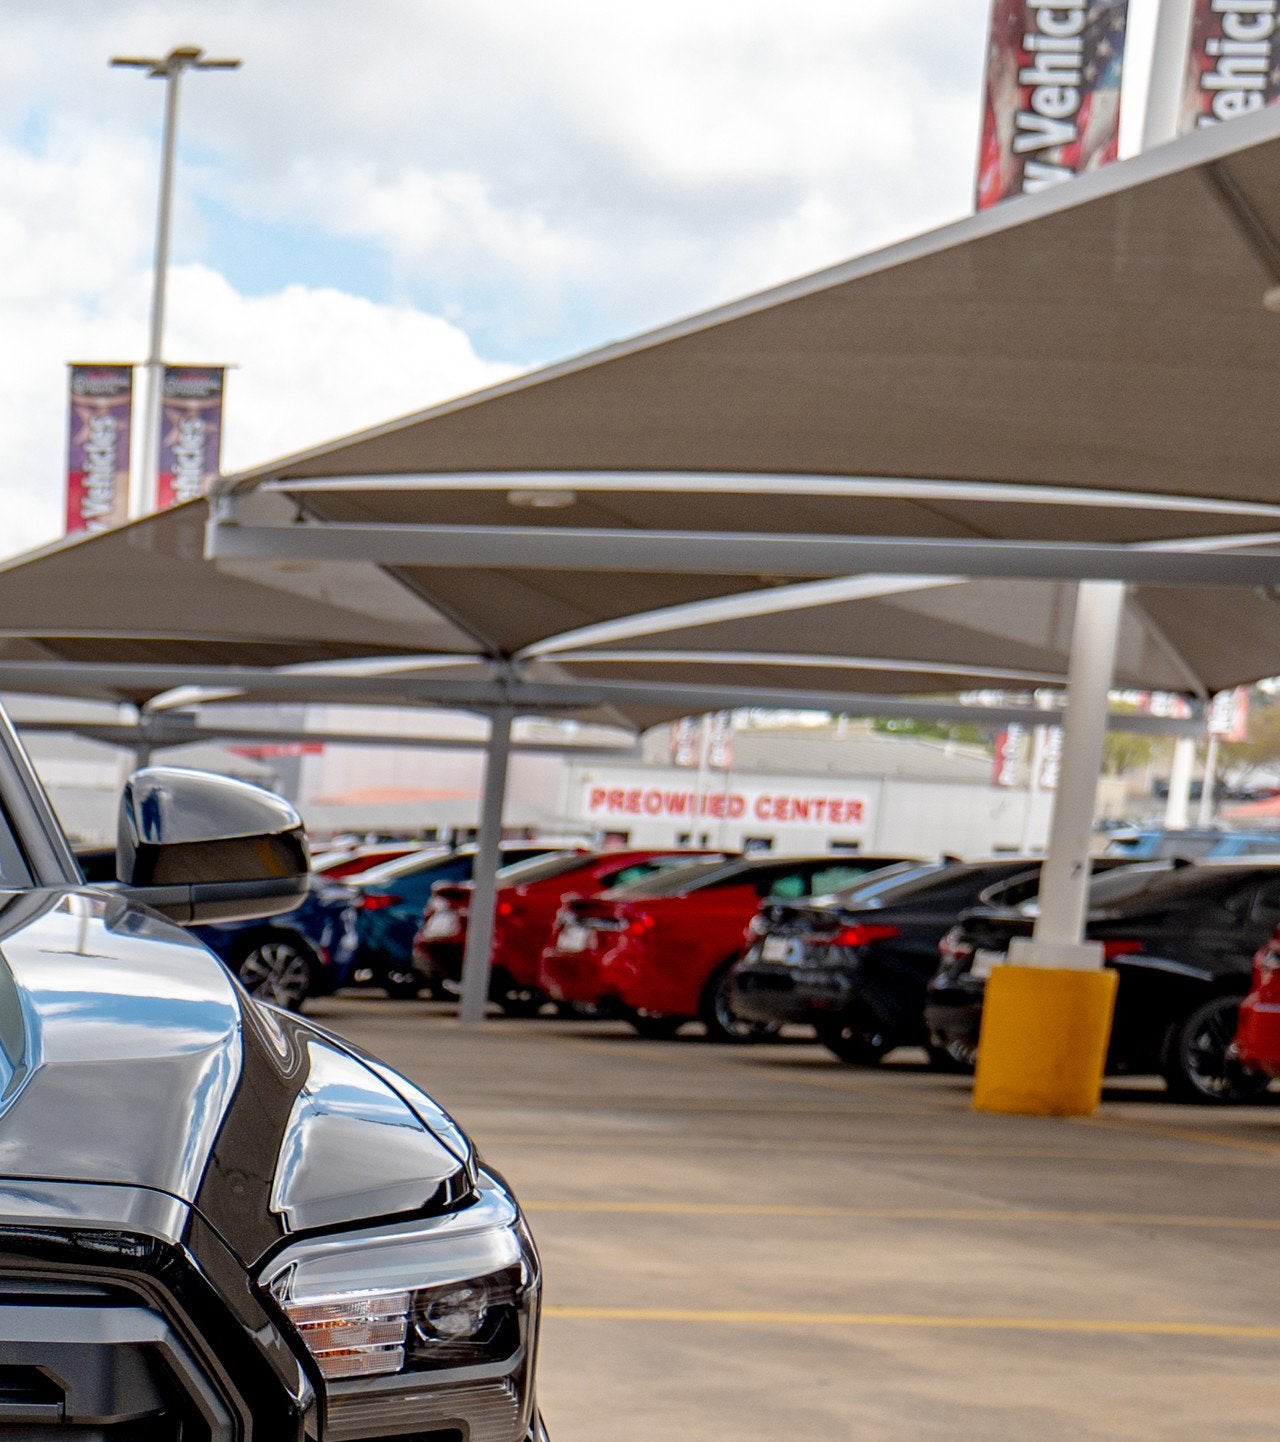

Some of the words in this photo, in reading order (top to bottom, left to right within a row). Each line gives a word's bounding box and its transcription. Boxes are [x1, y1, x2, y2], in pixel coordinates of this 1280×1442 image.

[1197, 0, 1278, 129] ehicl
[81, 416, 116, 518] Vehicles
[170, 417, 205, 505] ehicles
[754, 794, 864, 825] CENTER
